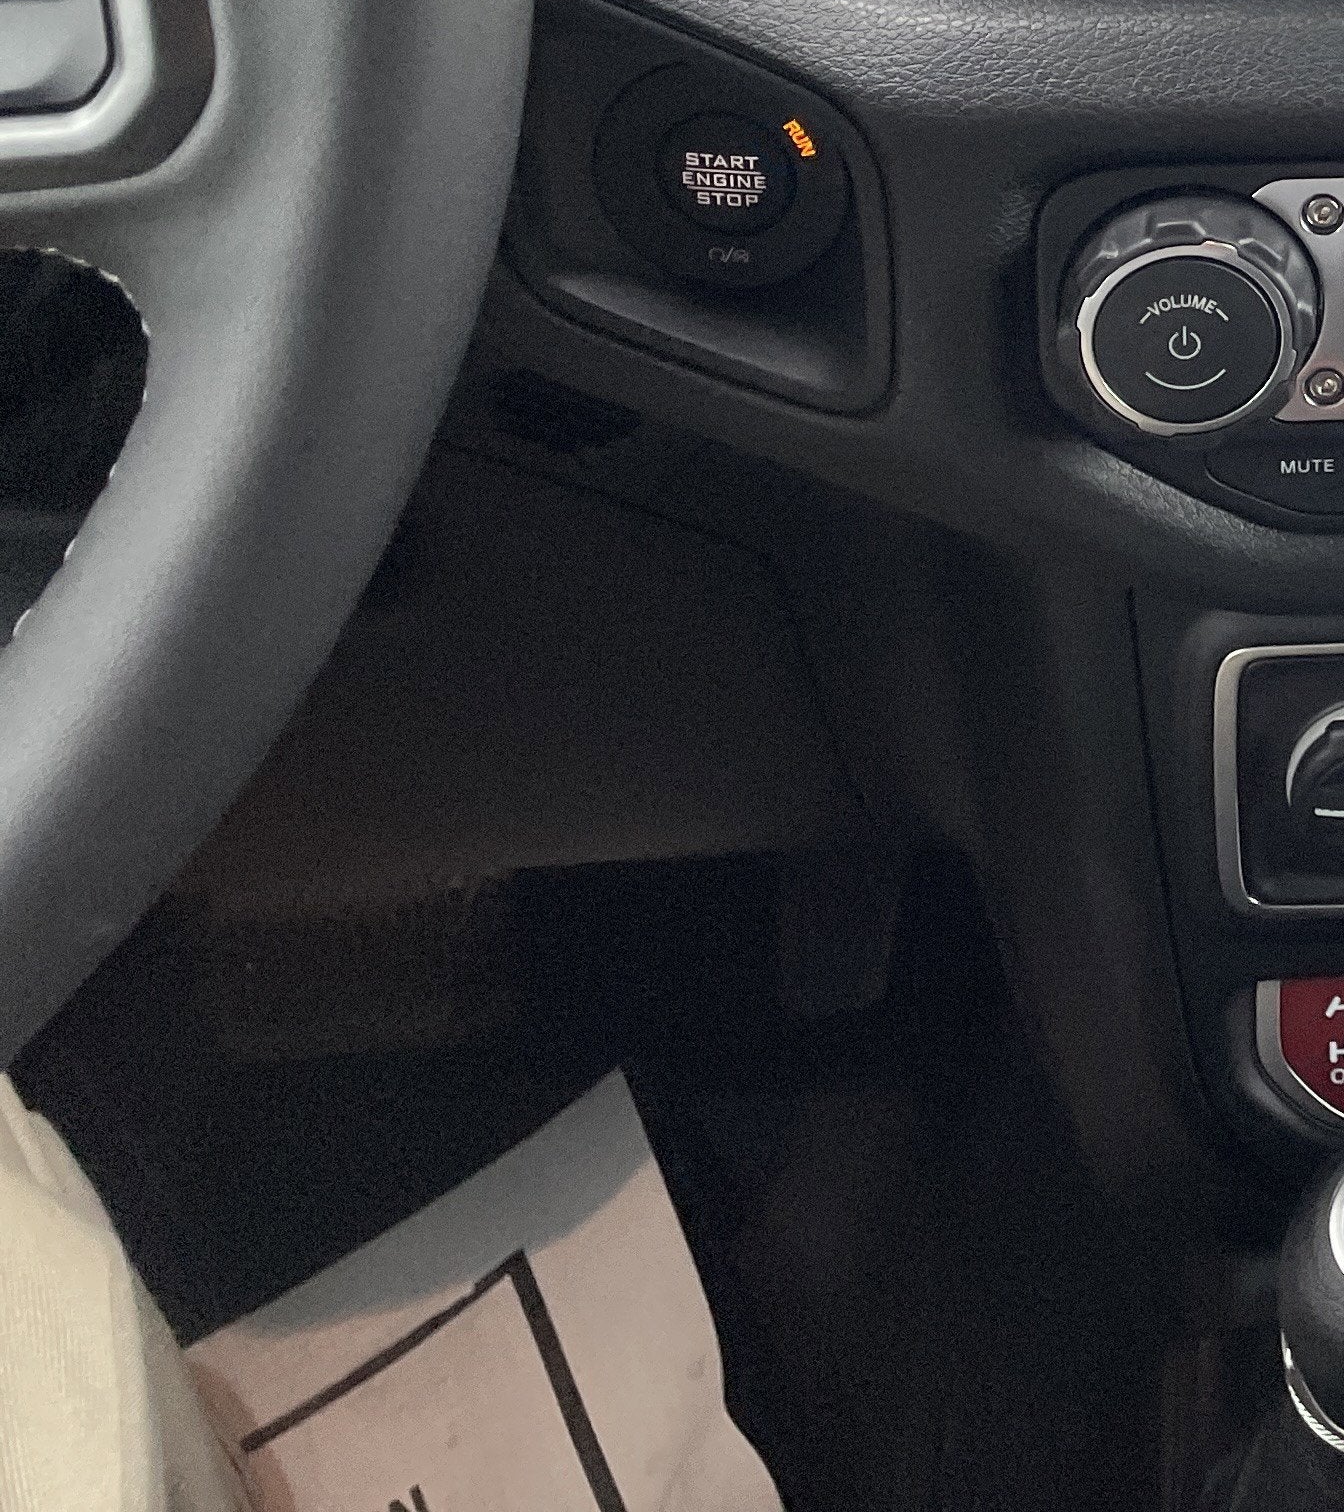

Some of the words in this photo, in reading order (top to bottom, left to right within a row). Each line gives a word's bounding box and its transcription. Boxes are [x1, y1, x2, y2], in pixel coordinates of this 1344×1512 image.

[782, 118, 816, 157] RUN
[685, 152, 759, 170] START
[682, 171, 767, 189] ENGINE
[697, 191, 759, 207] STOP
[1146, 294, 1218, 316] VOLUME
[1280, 458, 1335, 475] MUTE
